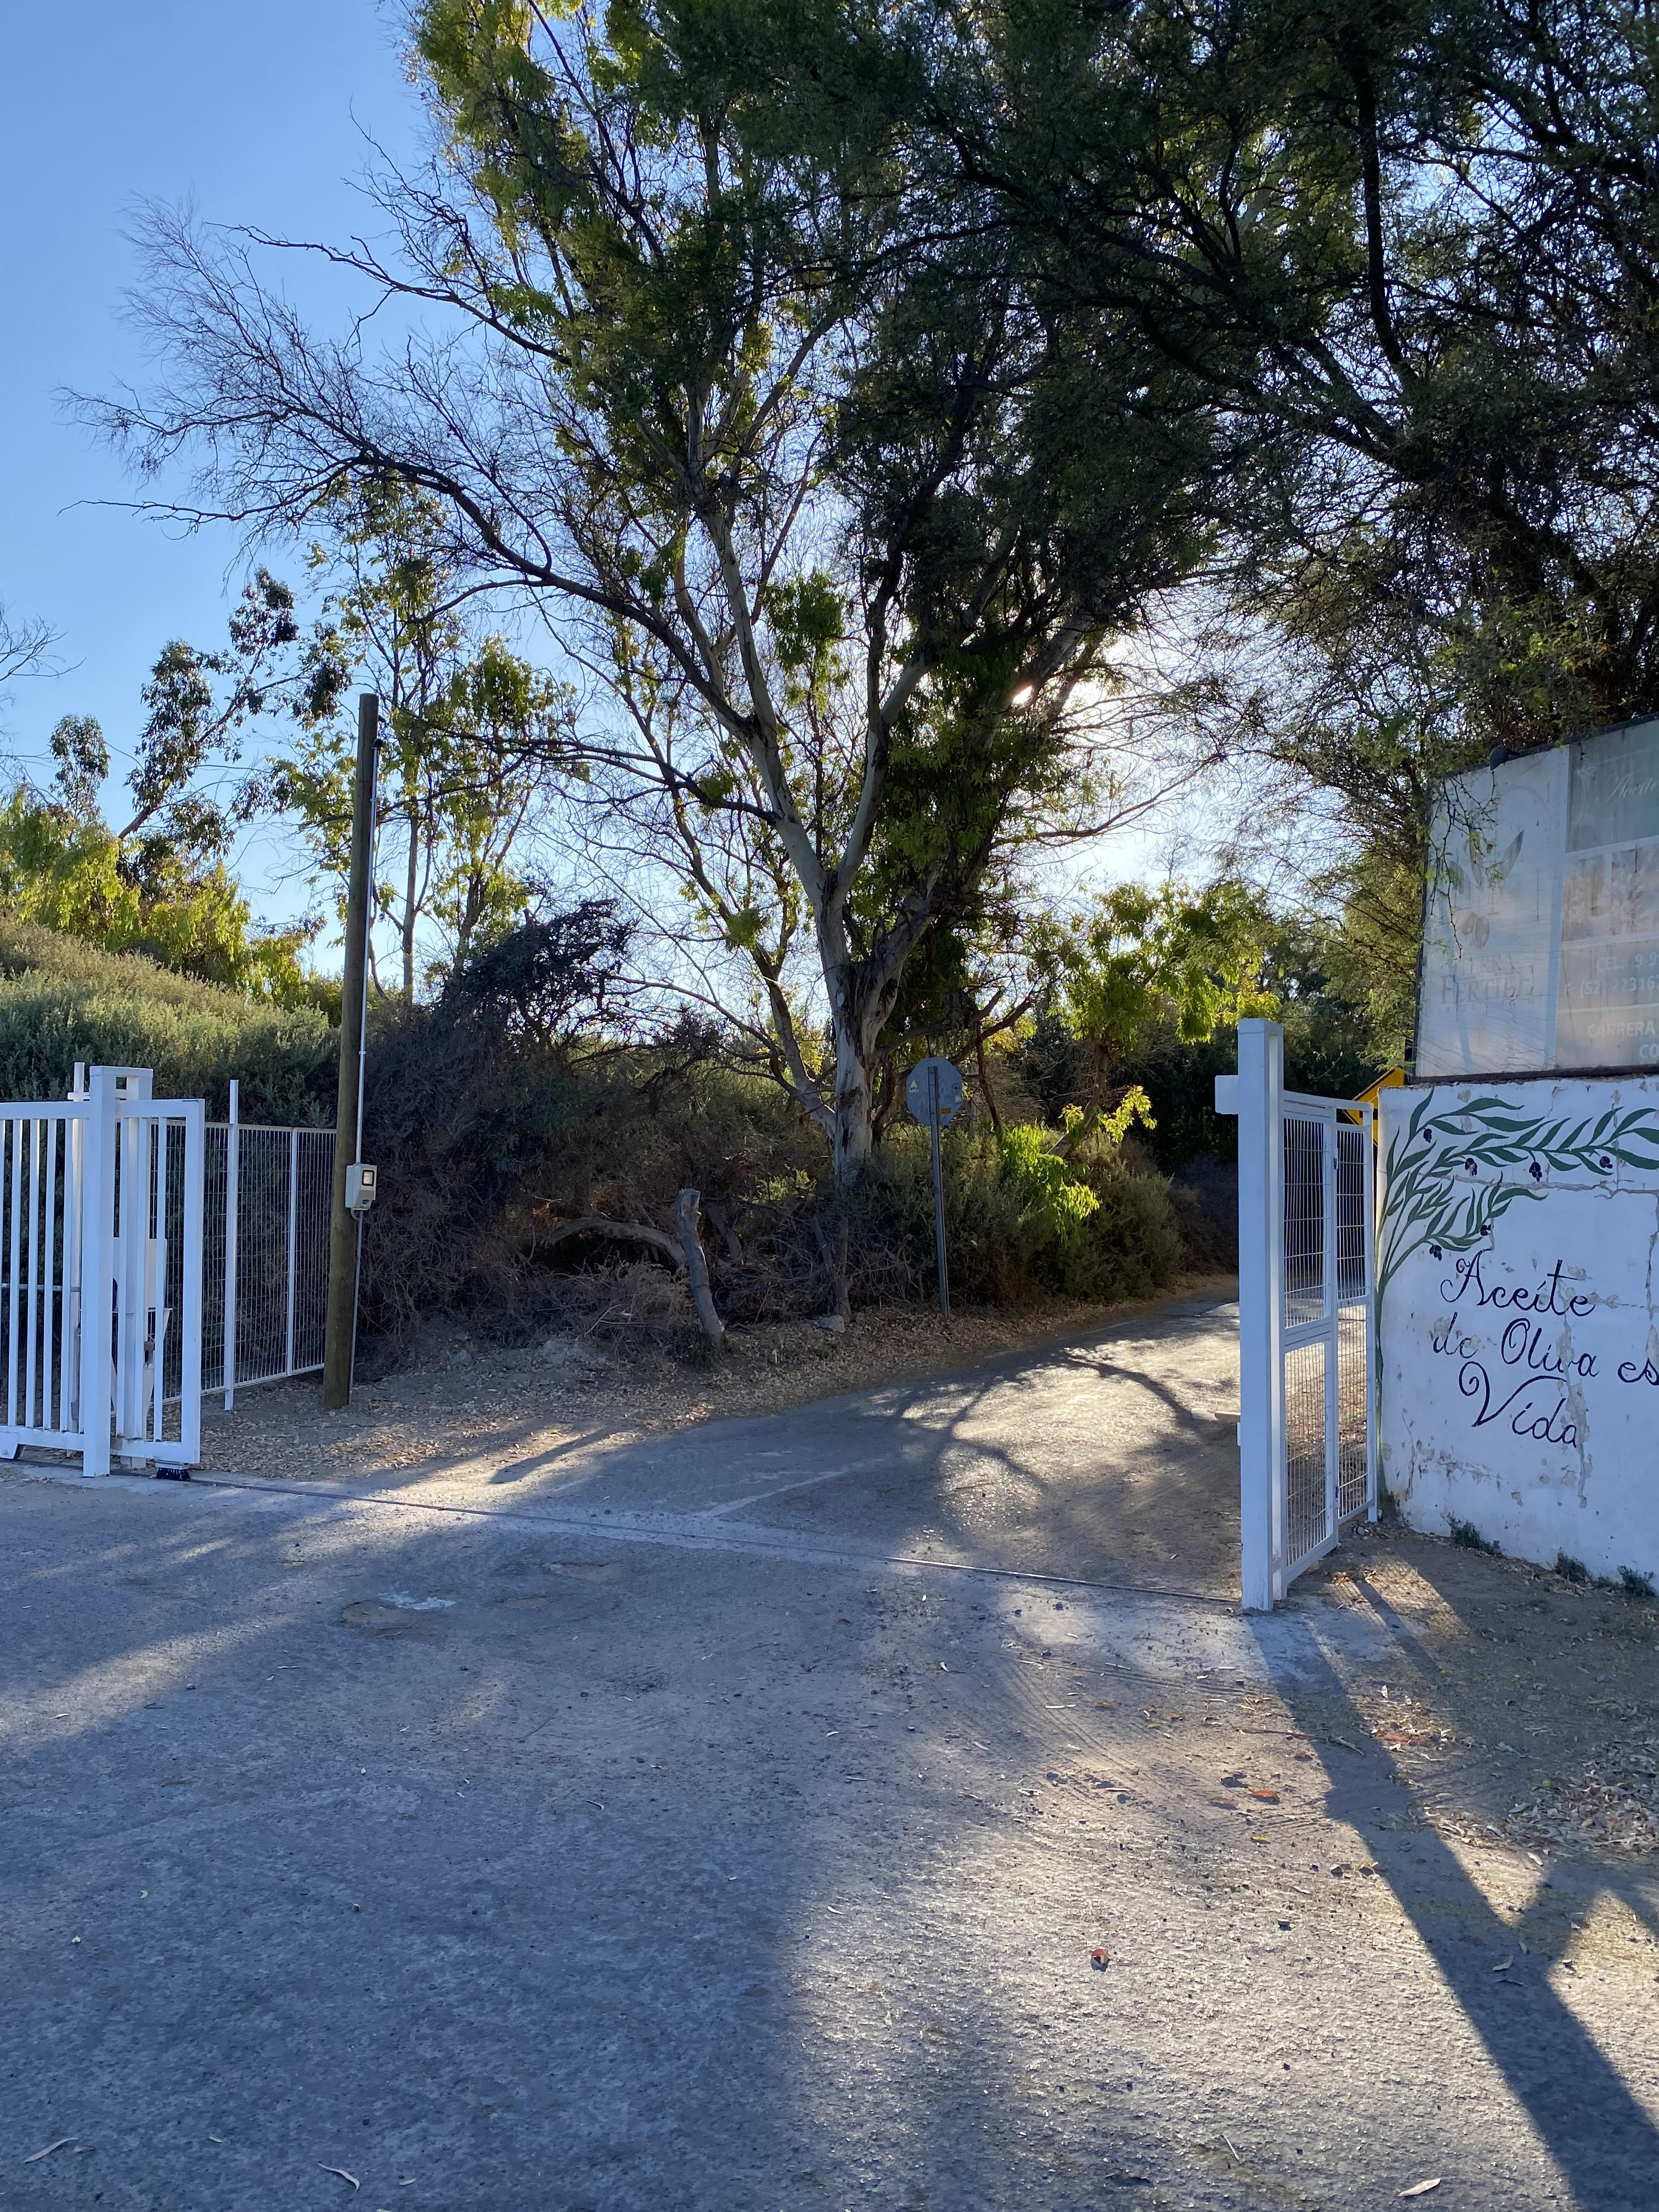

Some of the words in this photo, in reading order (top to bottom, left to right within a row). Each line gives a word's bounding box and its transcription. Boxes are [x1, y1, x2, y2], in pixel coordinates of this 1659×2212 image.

[1588, 1020, 1656, 1037] CARRERA
[1440, 1248, 1596, 1317] Aceite
[1501, 1318, 1600, 1378] Oliva
[1458, 1361, 1577, 1449] Vida
